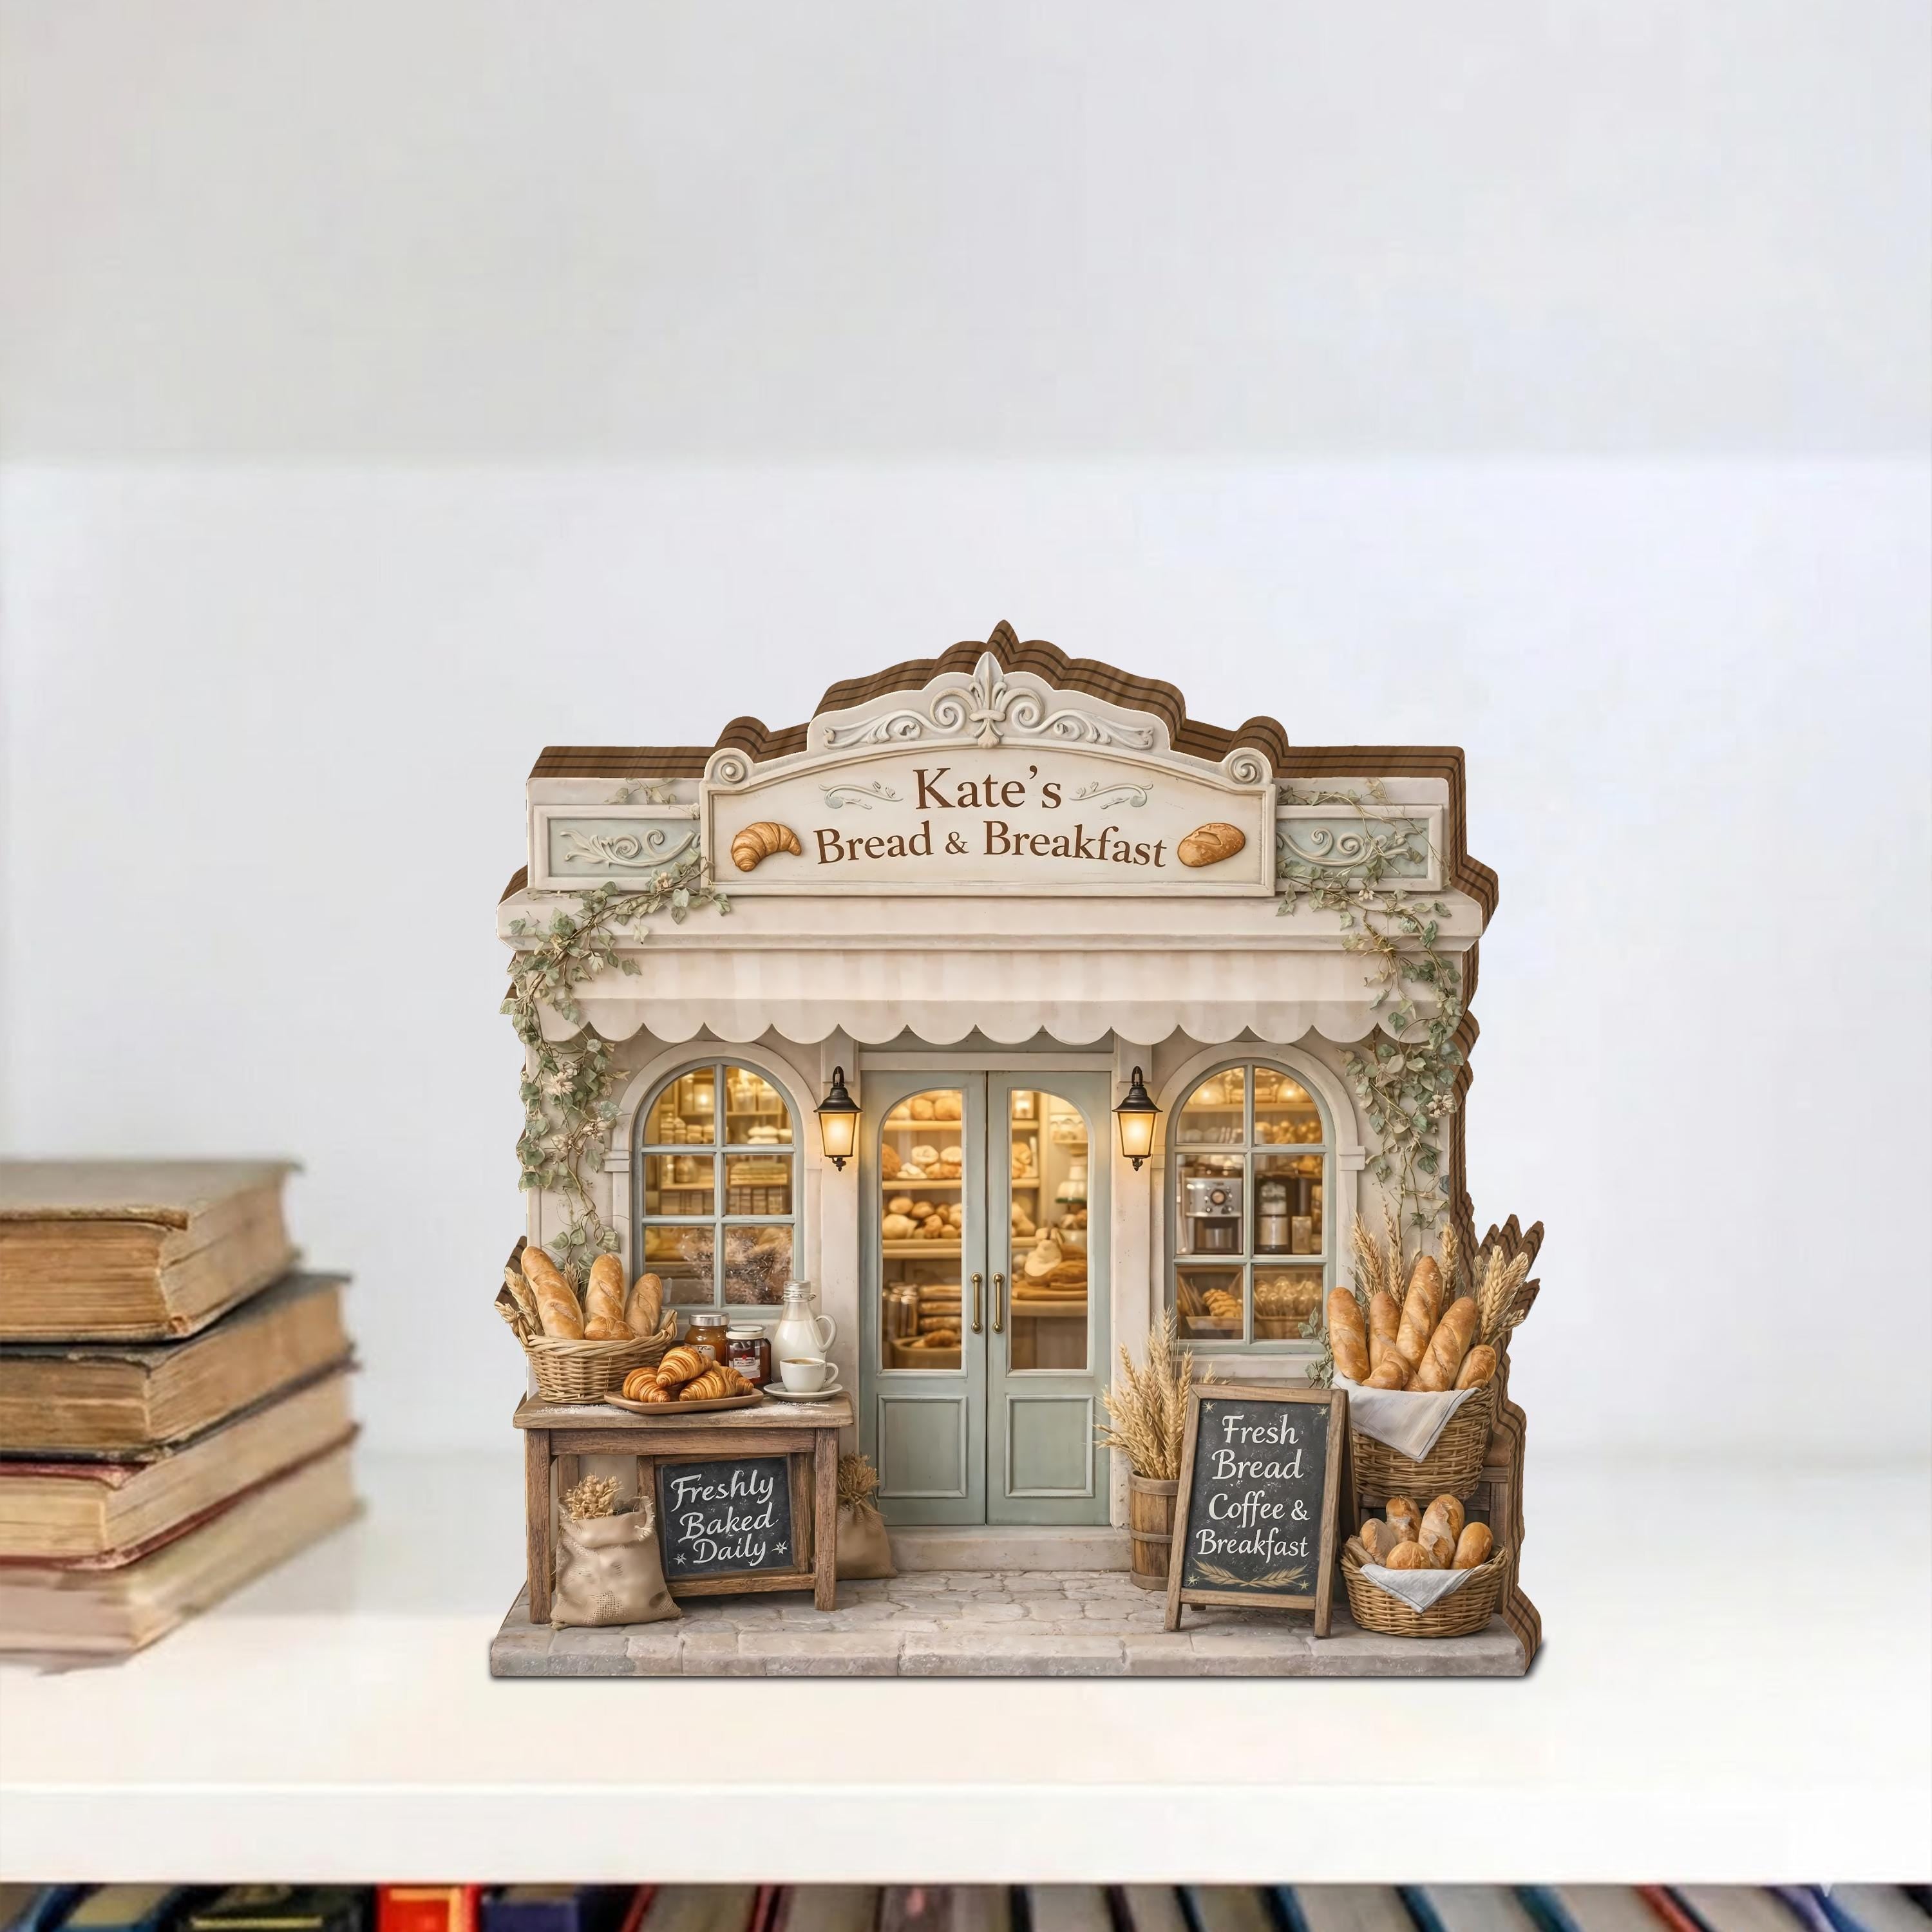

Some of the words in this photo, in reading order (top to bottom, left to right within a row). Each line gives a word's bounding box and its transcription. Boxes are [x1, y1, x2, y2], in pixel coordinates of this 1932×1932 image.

[913, 765, 1062, 810] Kate's
[813, 820, 931, 864] Bread
[945, 831, 968, 854] &
[983, 820, 1167, 867] Breakfast
[1222, 1414, 1298, 1444] Fresh
[1211, 1448, 1303, 1480] Bread
[670, 1469, 773, 1512] Freshly
[1208, 1490, 1285, 1528] Coffee
[1291, 1499, 1311, 1520] &
[677, 1501, 779, 1544] Baked
[693, 1533, 766, 1566] Daily
[1196, 1527, 1310, 1564] Breakfast
